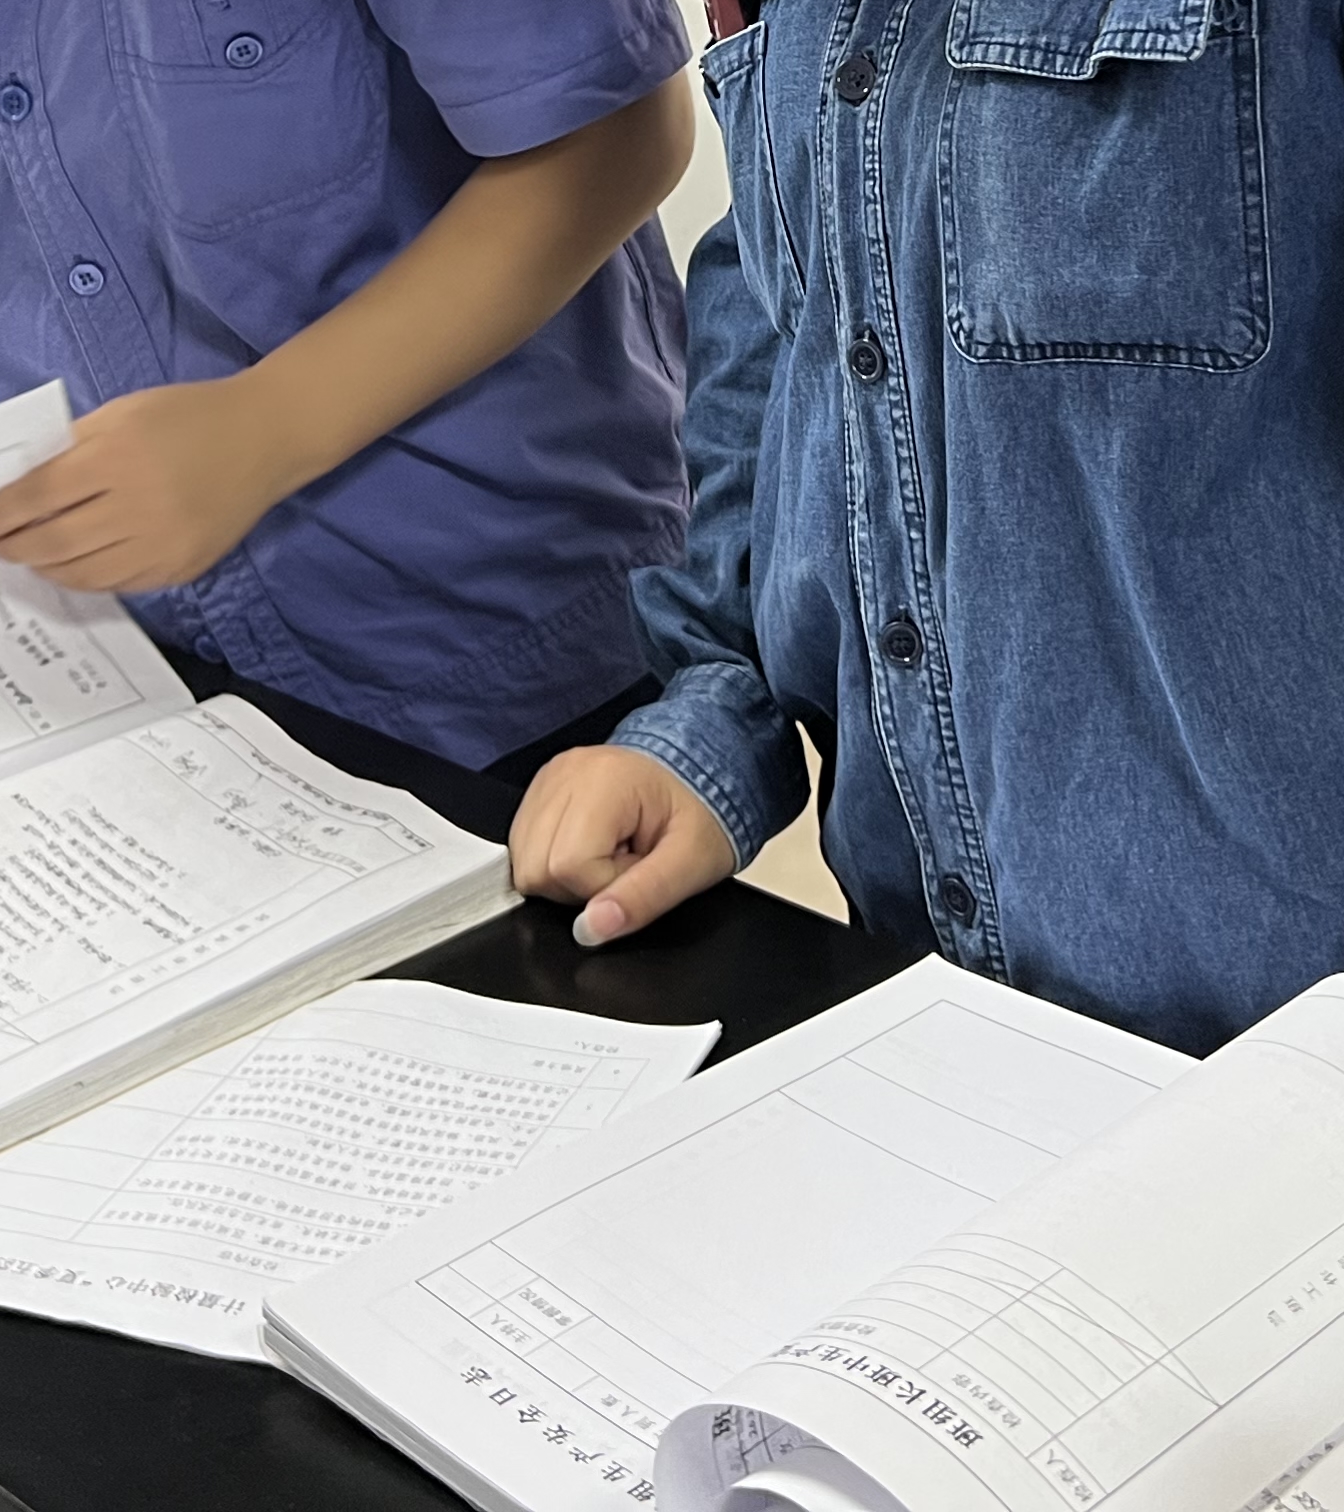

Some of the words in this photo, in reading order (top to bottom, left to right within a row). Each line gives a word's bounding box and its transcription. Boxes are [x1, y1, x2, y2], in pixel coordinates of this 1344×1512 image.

[487, 1312, 532, 1346] 主持人
[949, 1370, 1024, 1429] 检查内容
[1047, 1446, 1095, 1503] 检查人
